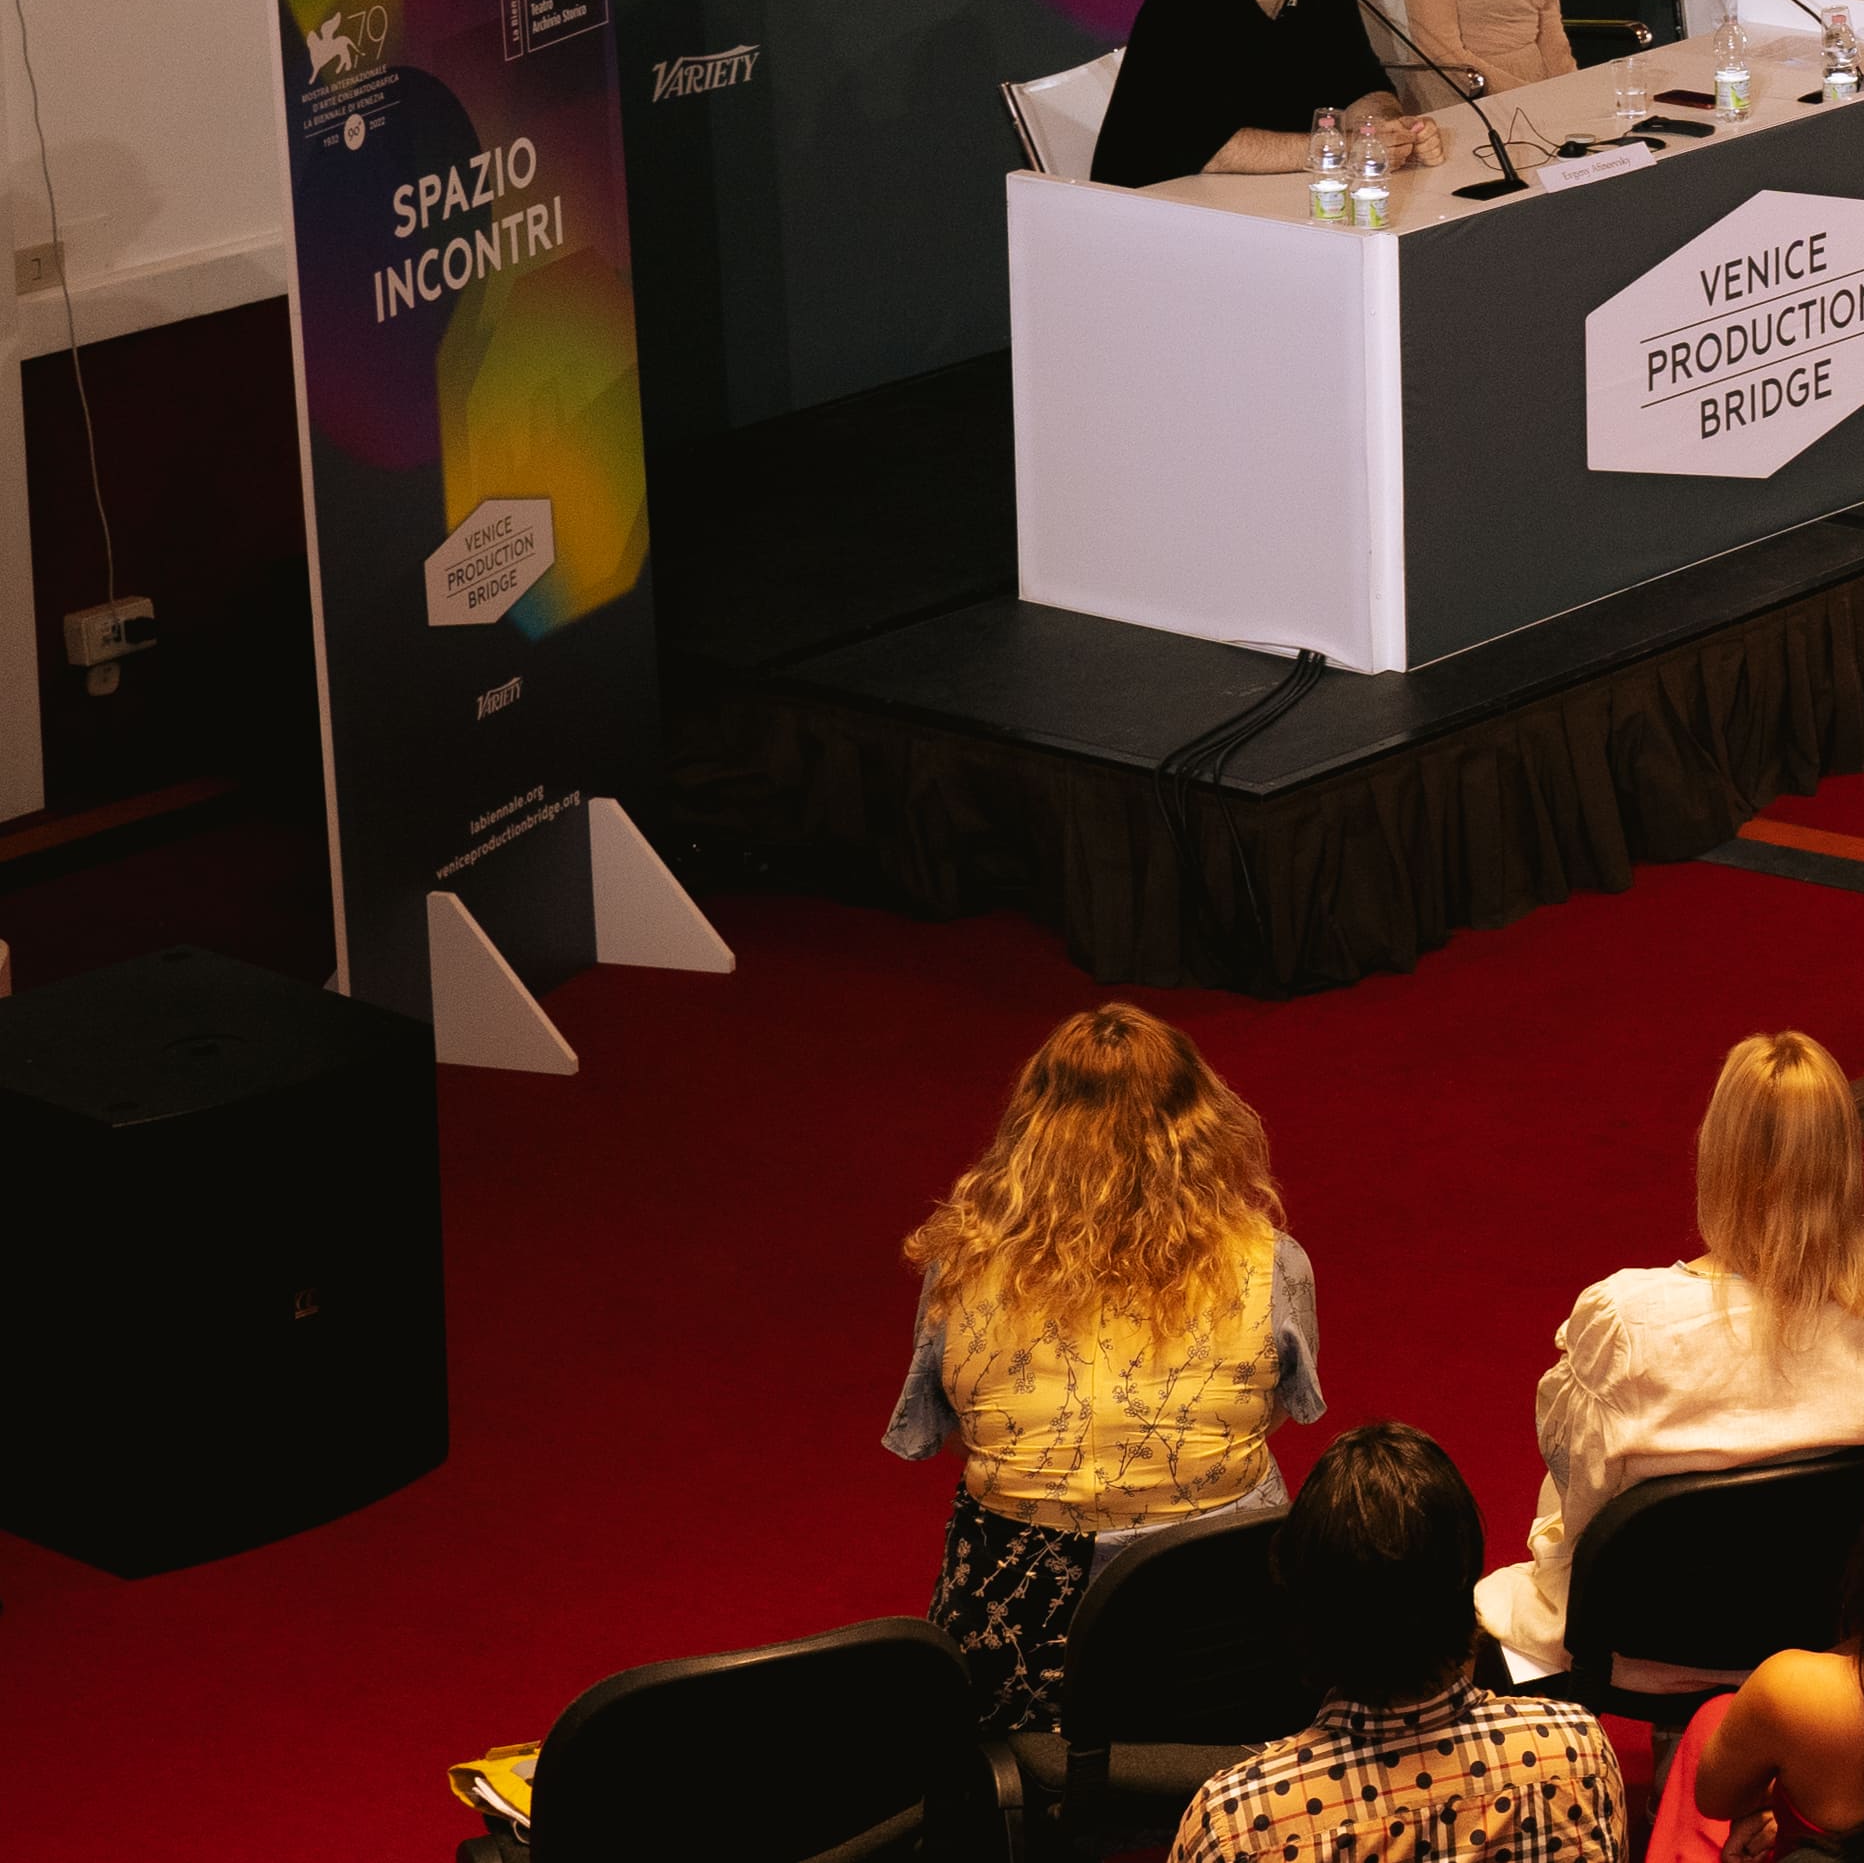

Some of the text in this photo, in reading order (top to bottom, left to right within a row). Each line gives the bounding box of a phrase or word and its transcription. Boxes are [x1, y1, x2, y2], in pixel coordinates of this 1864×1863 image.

[347, 5, 388, 68] 79
[652, 44, 760, 103] VARIETY
[393, 137, 536, 238] SPAZIO
[374, 195, 563, 323] INCONTRI
[1700, 231, 1827, 306] VENICE
[1701, 358, 1832, 440] BRIDGE
[447, 533, 535, 592] PRODUCTION
[465, 516, 512, 553] VENICE
[468, 569, 518, 609] BRIDGE
[476, 676, 523, 721] VARIETY
[436, 789, 581, 880] veniceproductionbridge.org
[469, 783, 544, 835] labiennale.org
